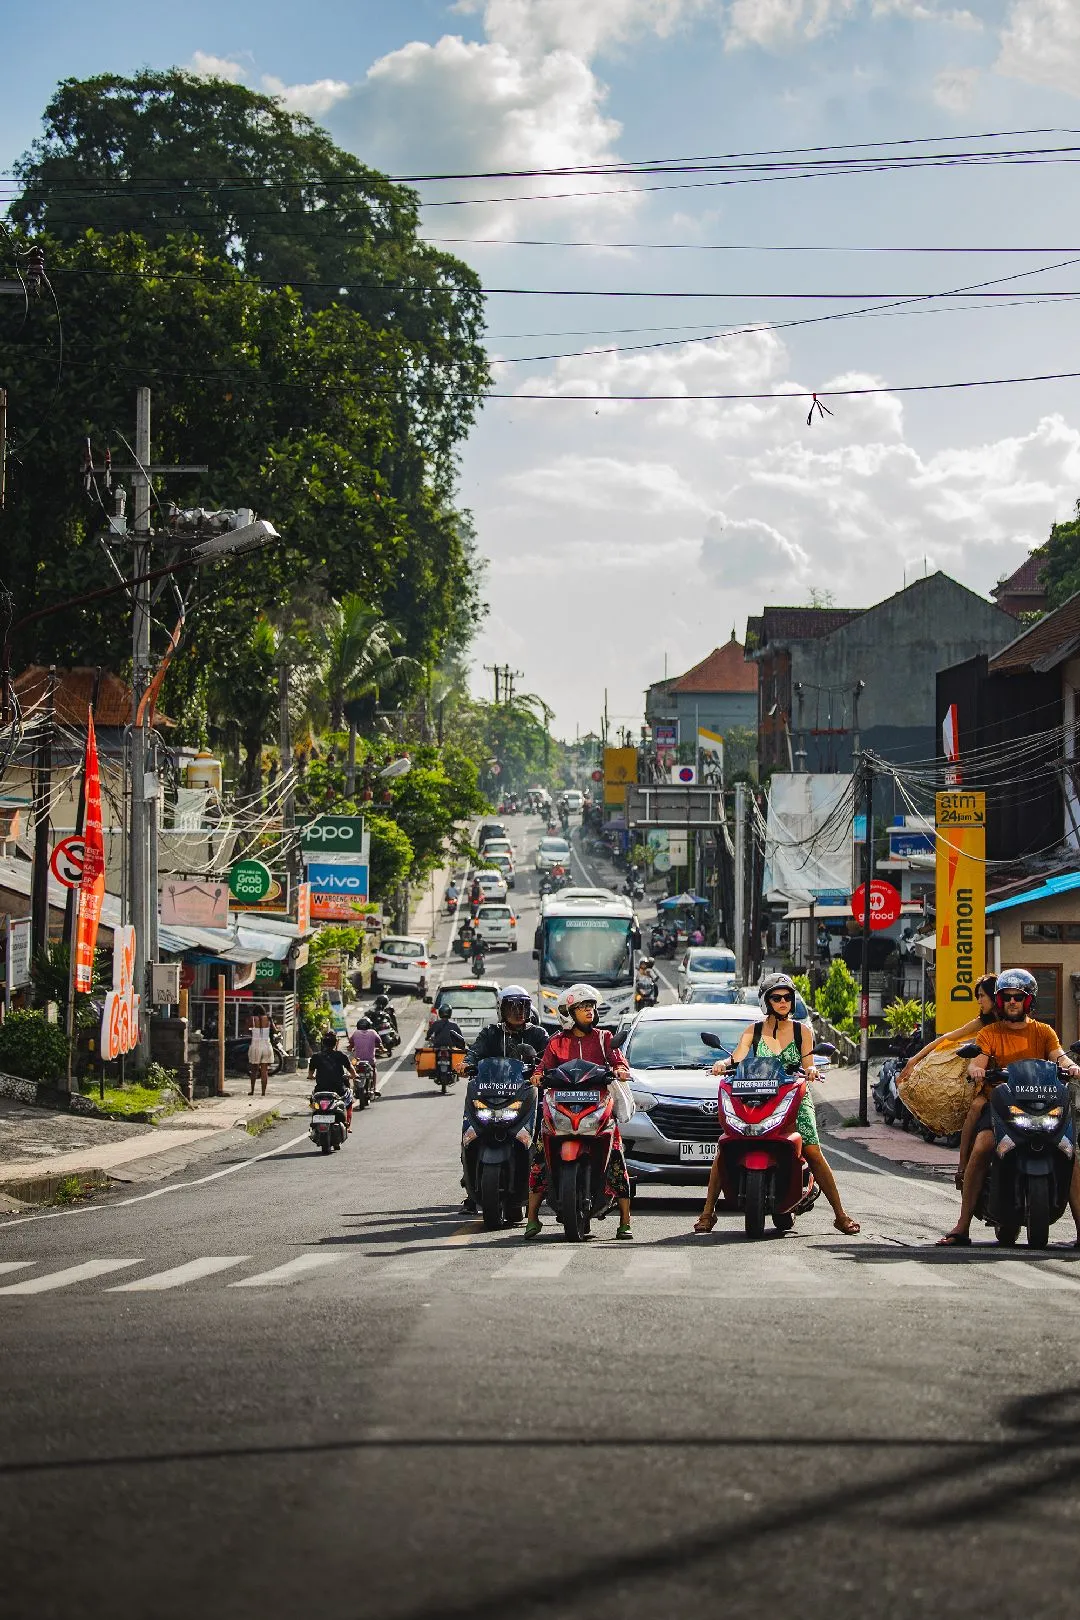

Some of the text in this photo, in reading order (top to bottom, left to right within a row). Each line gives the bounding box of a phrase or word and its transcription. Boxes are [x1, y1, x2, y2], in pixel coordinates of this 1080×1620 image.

[940, 794, 976, 809] atm
[237, 874, 262, 884] Grab
[315, 873, 360, 888] vivo
[236, 883, 262, 894] Food
[858, 911, 894, 922] gfood
[950, 888, 973, 1002] Danamon
[256, 967, 274, 976] ood
[682, 1144, 694, 1155] DK
